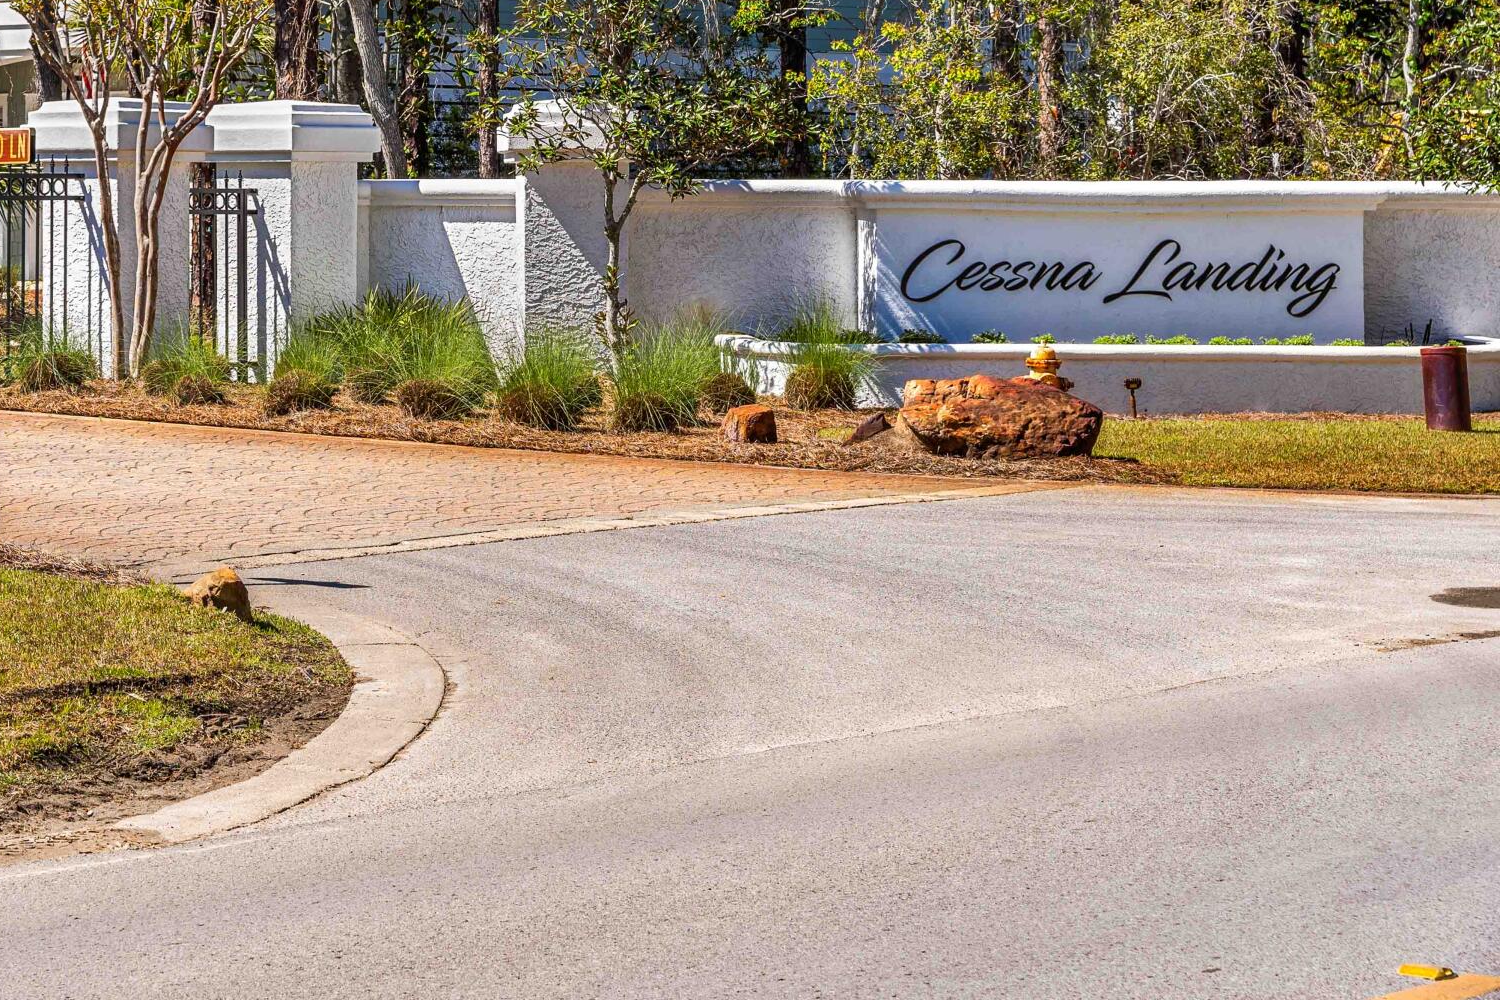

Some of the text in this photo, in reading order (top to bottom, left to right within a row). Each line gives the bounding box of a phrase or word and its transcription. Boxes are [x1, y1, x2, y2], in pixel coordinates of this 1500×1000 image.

[9, 133, 26, 159] LN
[899, 238, 1342, 319] Cessna Landing
